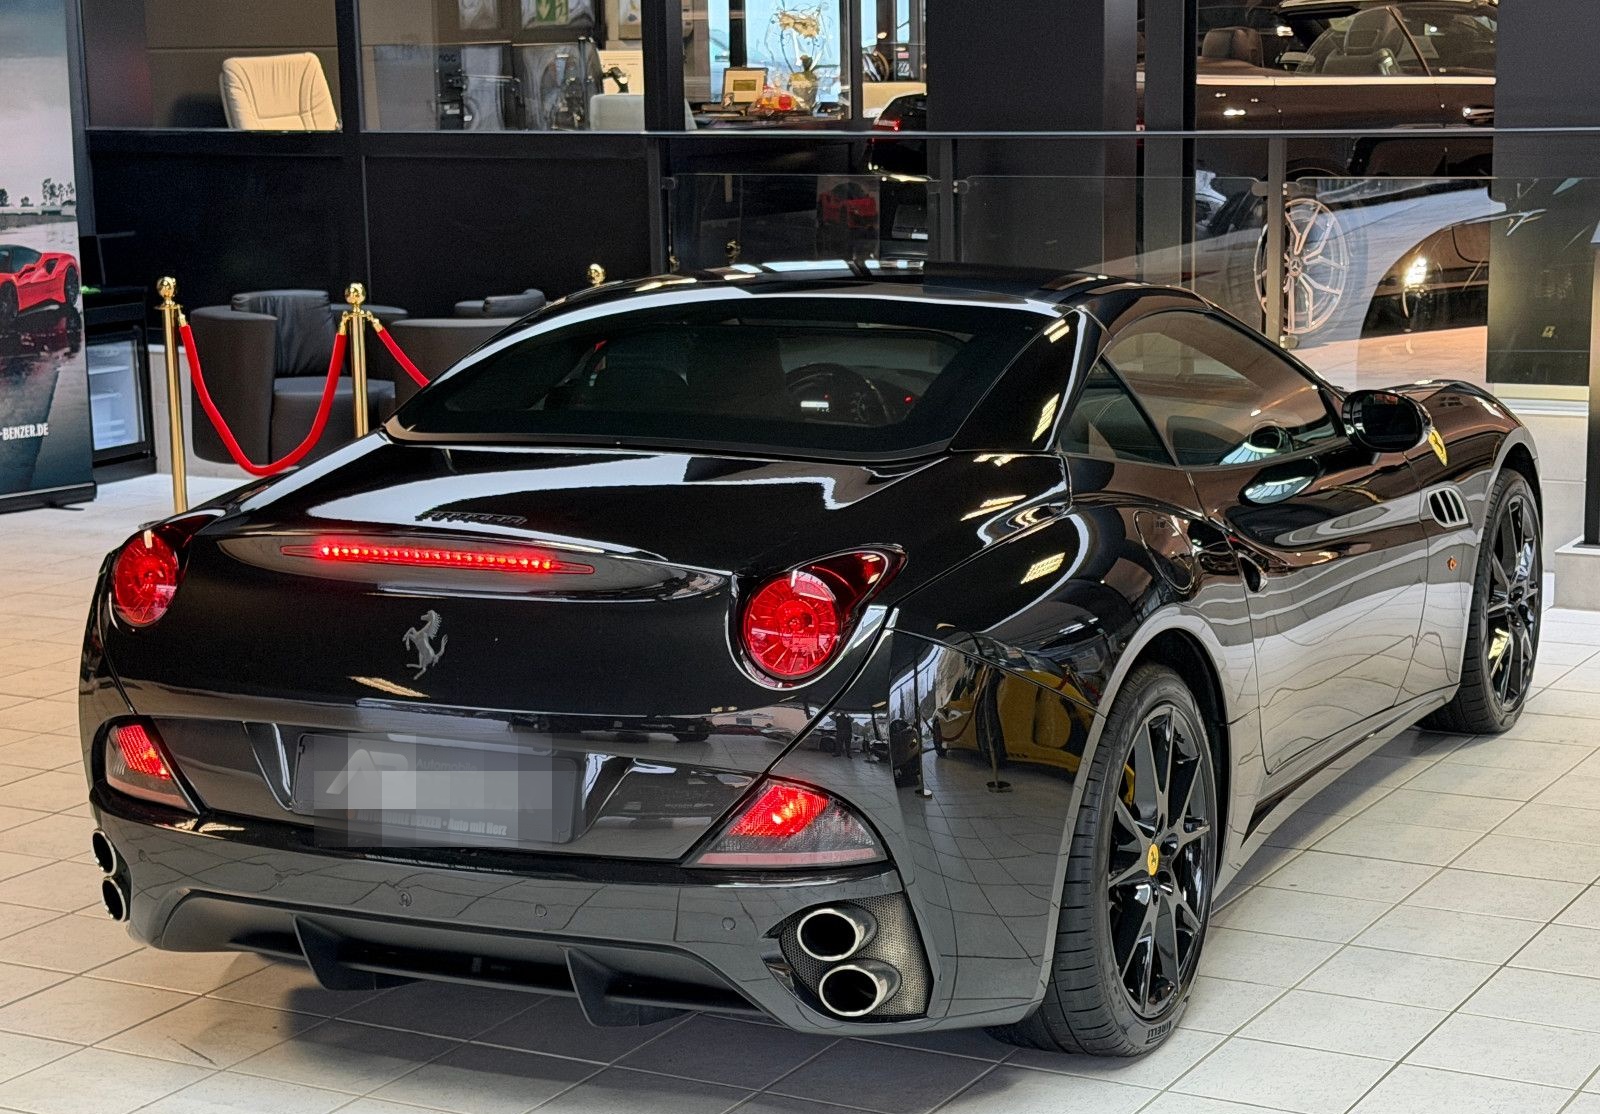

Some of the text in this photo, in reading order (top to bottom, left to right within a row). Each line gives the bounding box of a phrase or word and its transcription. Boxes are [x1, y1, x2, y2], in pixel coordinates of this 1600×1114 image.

[447, 817, 469, 832] Auto
[469, 820, 486, 834] mit
[486, 821, 508, 836] Herz
